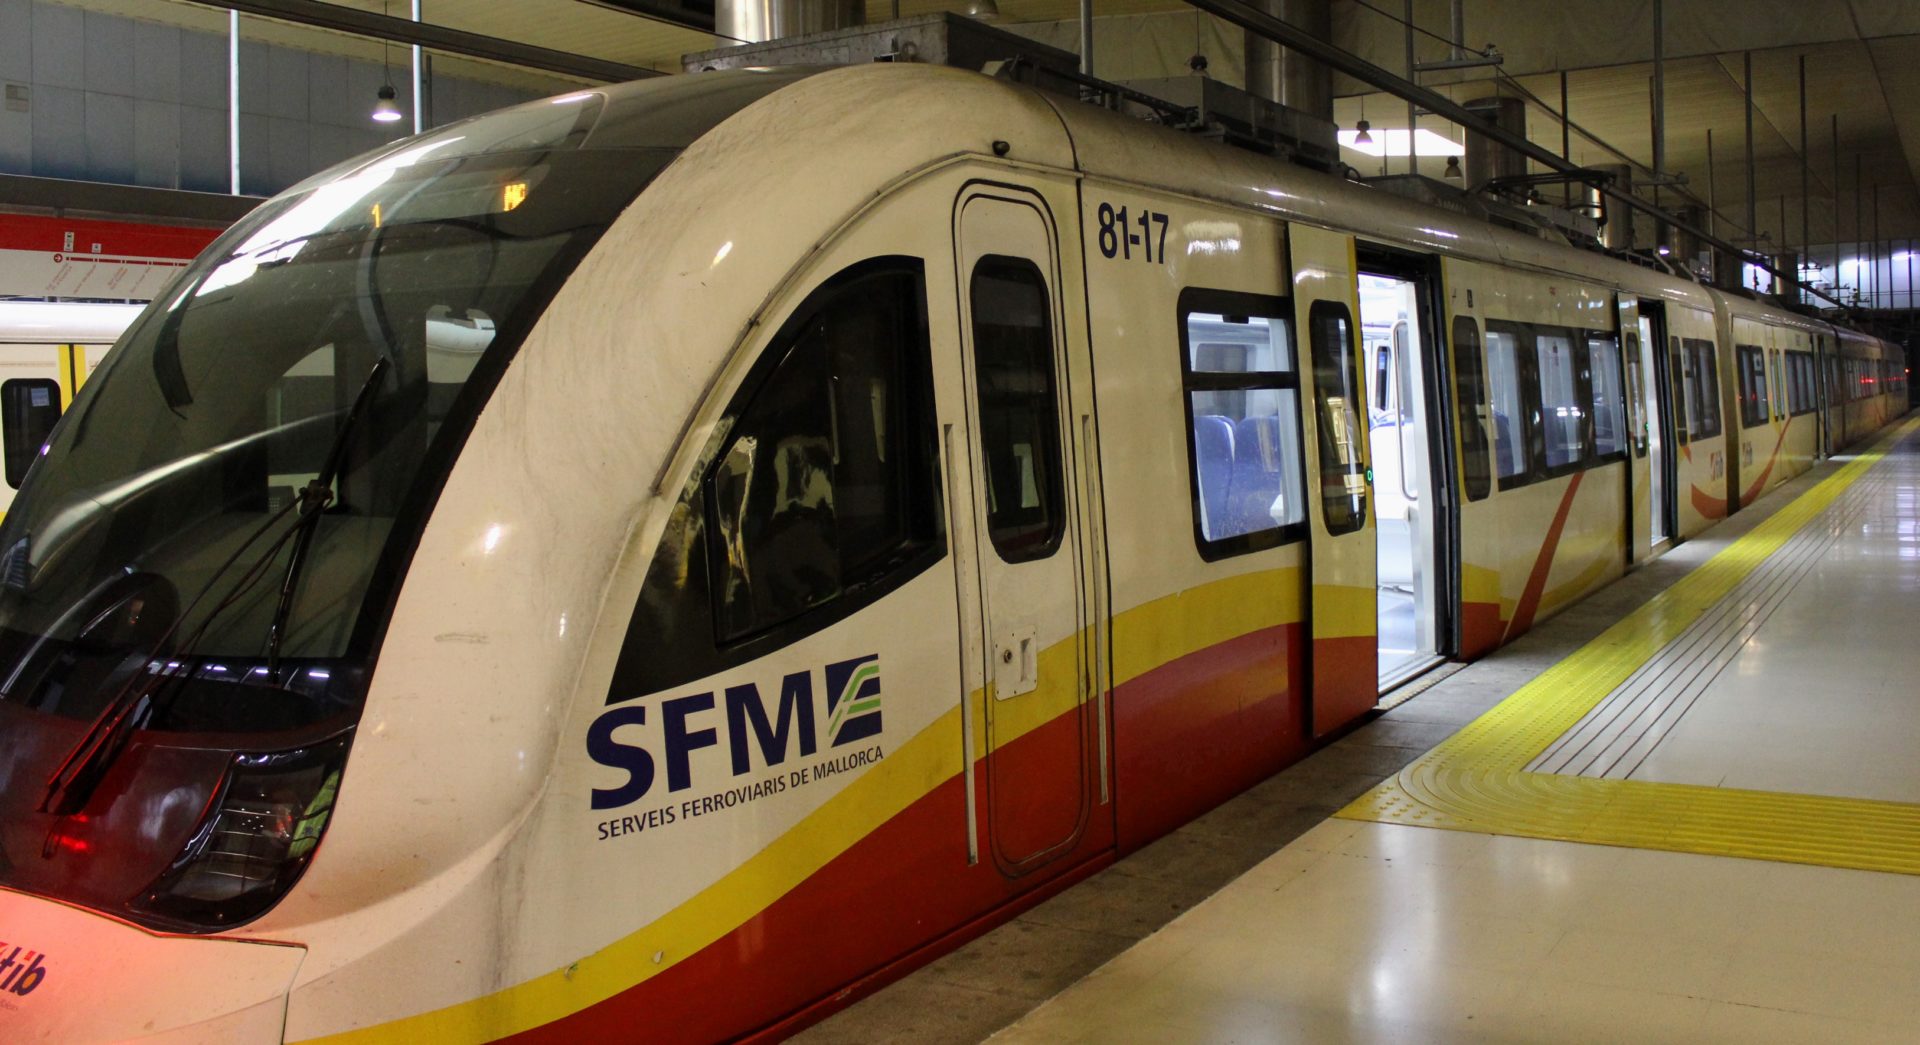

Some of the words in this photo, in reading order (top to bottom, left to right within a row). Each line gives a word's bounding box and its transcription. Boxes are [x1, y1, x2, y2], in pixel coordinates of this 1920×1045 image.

[371, 203, 381, 228] 1
[1098, 202, 1169, 264] 81-17
[586, 669, 817, 810] SFM
[597, 806, 676, 841] SERVEIS
[682, 775, 786, 820] FERROVIARIS
[790, 768, 808, 788] DE
[813, 745, 884, 781] MALLORCA
